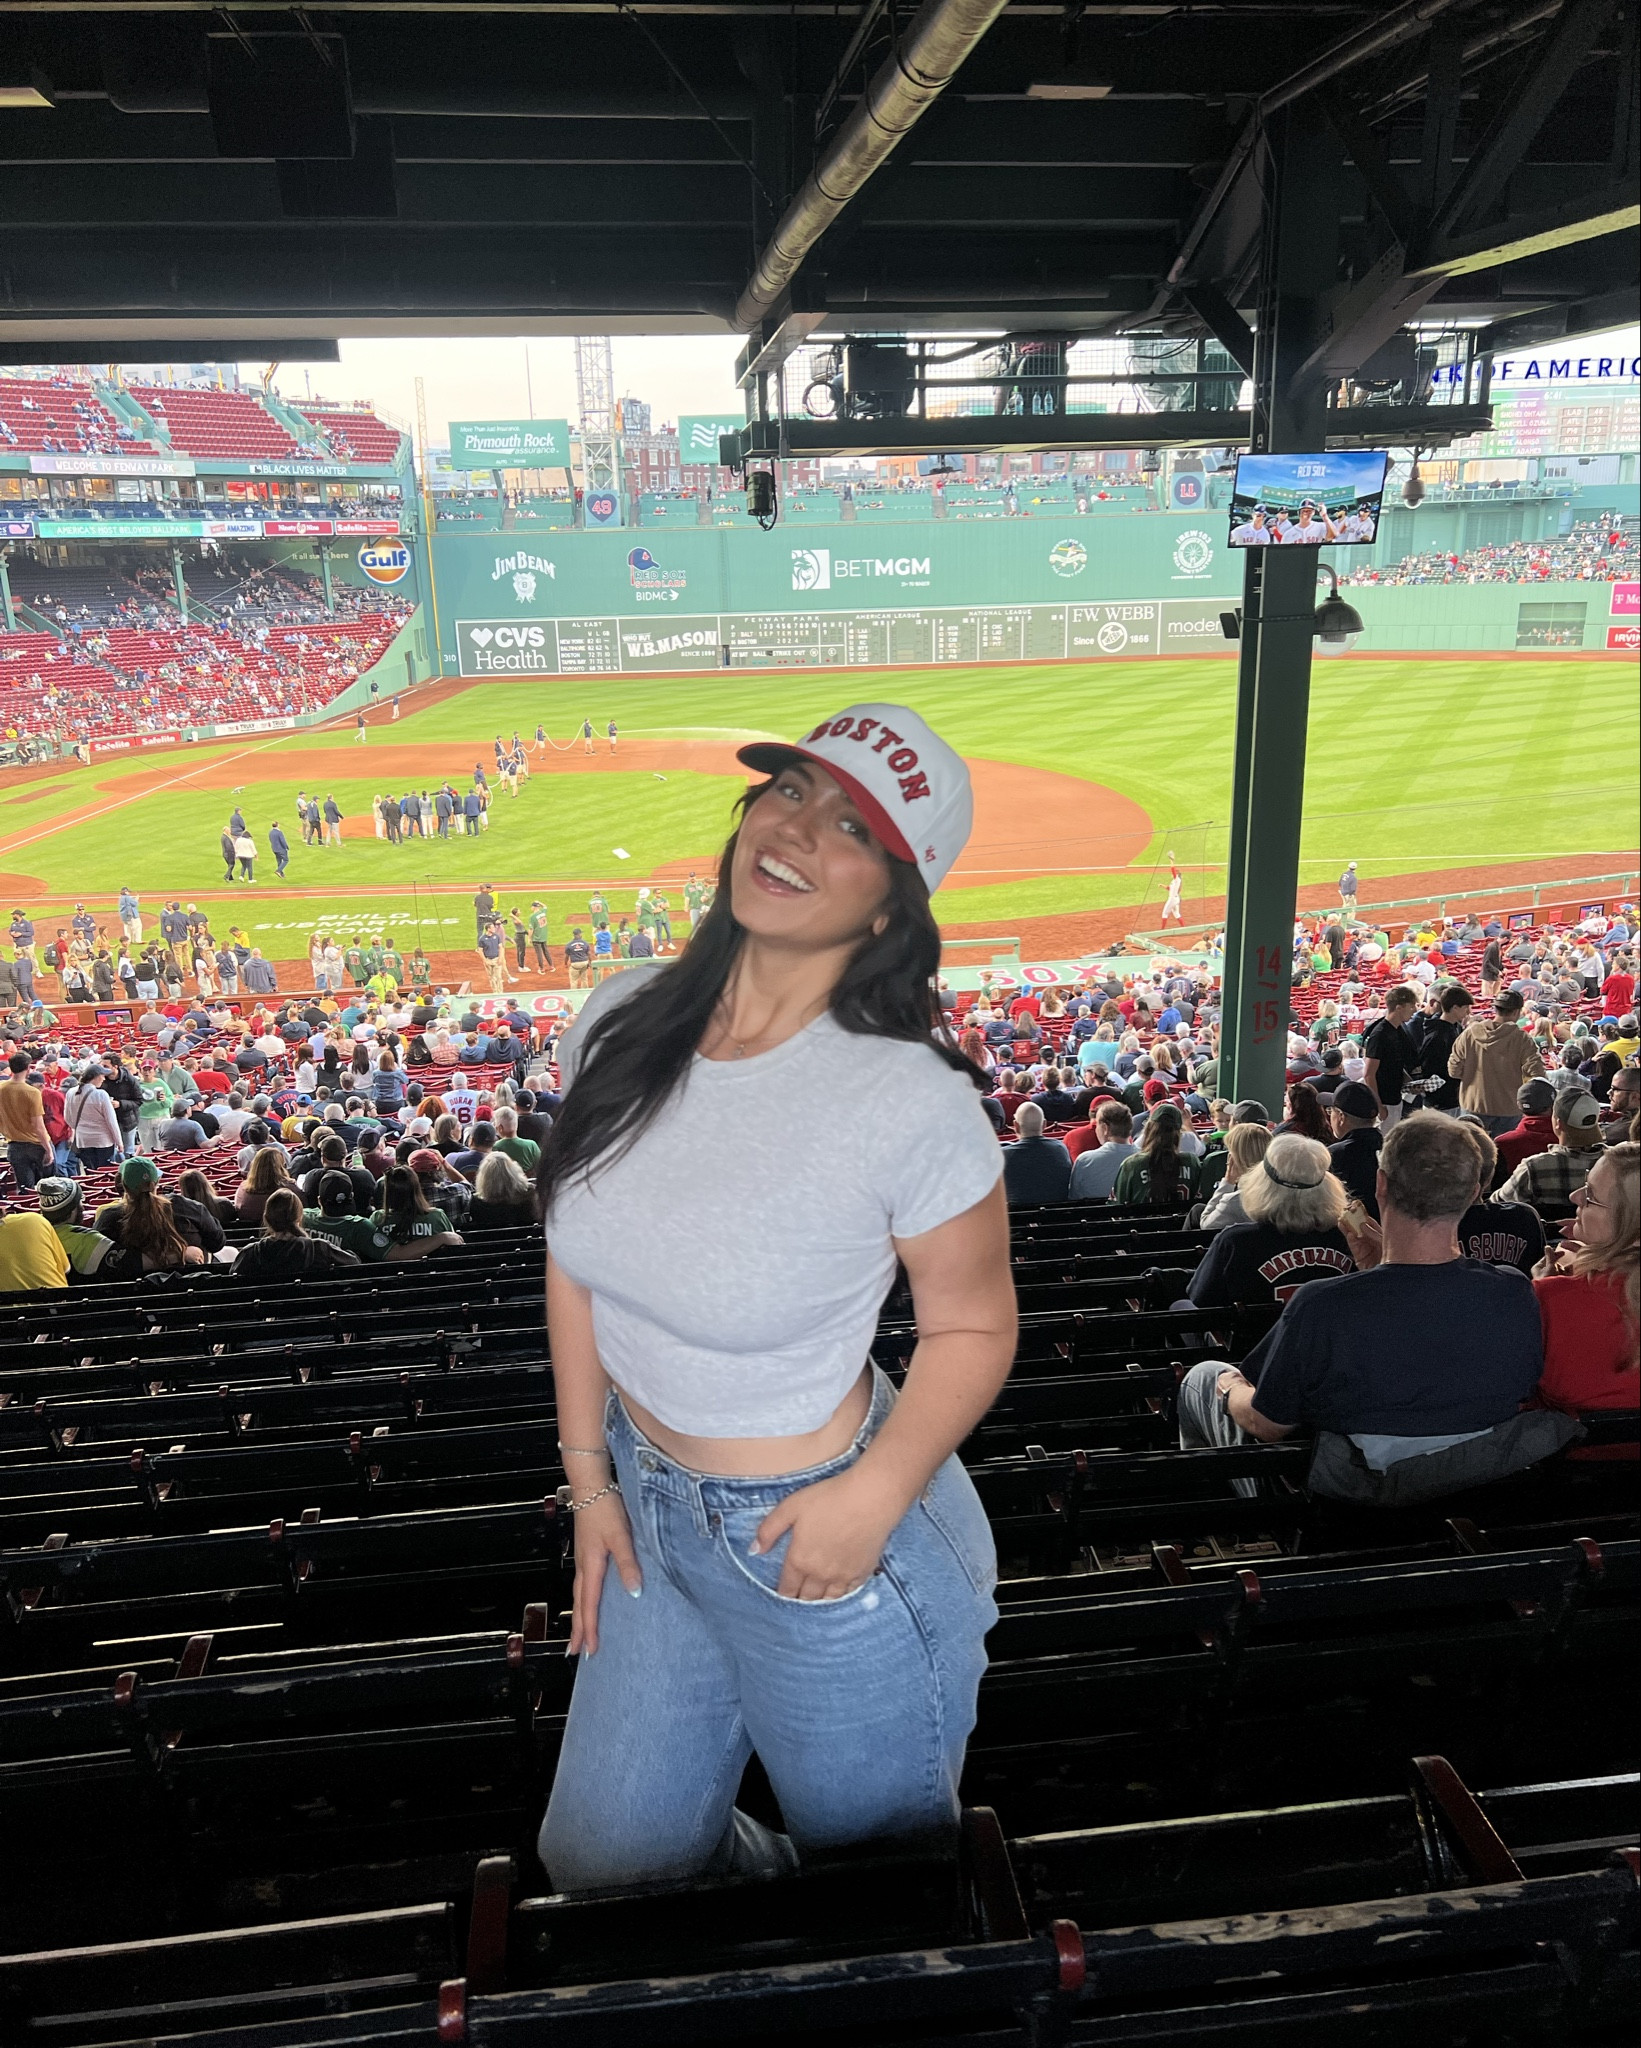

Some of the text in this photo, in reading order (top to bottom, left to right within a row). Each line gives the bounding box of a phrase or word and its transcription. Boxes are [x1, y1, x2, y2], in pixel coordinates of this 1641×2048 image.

[1544, 391, 1562, 400] 6:41
[465, 433, 555, 450] Plymouth Rock
[56, 460, 174, 473] WELCOME TO FENWAY PARK
[263, 465, 347, 476] BLACK LIVES MATTER
[1297, 465, 1326, 478] RED SOX
[56, 526, 96, 534] AMERICA'S
[98, 526, 117, 534] MOST
[119, 526, 151, 534] BELOVED
[337, 524, 368, 532] Safelite
[360, 550, 406, 567] Gulf
[492, 551, 556, 580] JIM BEAM
[834, 557, 930, 578] BETMGM
[636, 570, 686, 579] RED SOX
[636, 592, 668, 601] BIDMC
[1105, 606, 1154, 622] WEBB
[494, 626, 546, 648] CVS
[1130, 635, 1149, 643] 1866
[475, 650, 548, 670] Health
[95, 740, 130, 750] Safelite
[142, 735, 175, 745] Safelite
[807, 717, 931, 804] BOSTON
[317, 912, 411, 921] BUILD
[253, 918, 460, 930] SUBMARINES
[1256, 945, 1281, 977] 14
[978, 962, 1109, 986] SOX
[1253, 1000, 1280, 1032] 15
[449, 1096, 474, 1106] DURAN
[1258, 1247, 1353, 1283] MATSUZAKA
